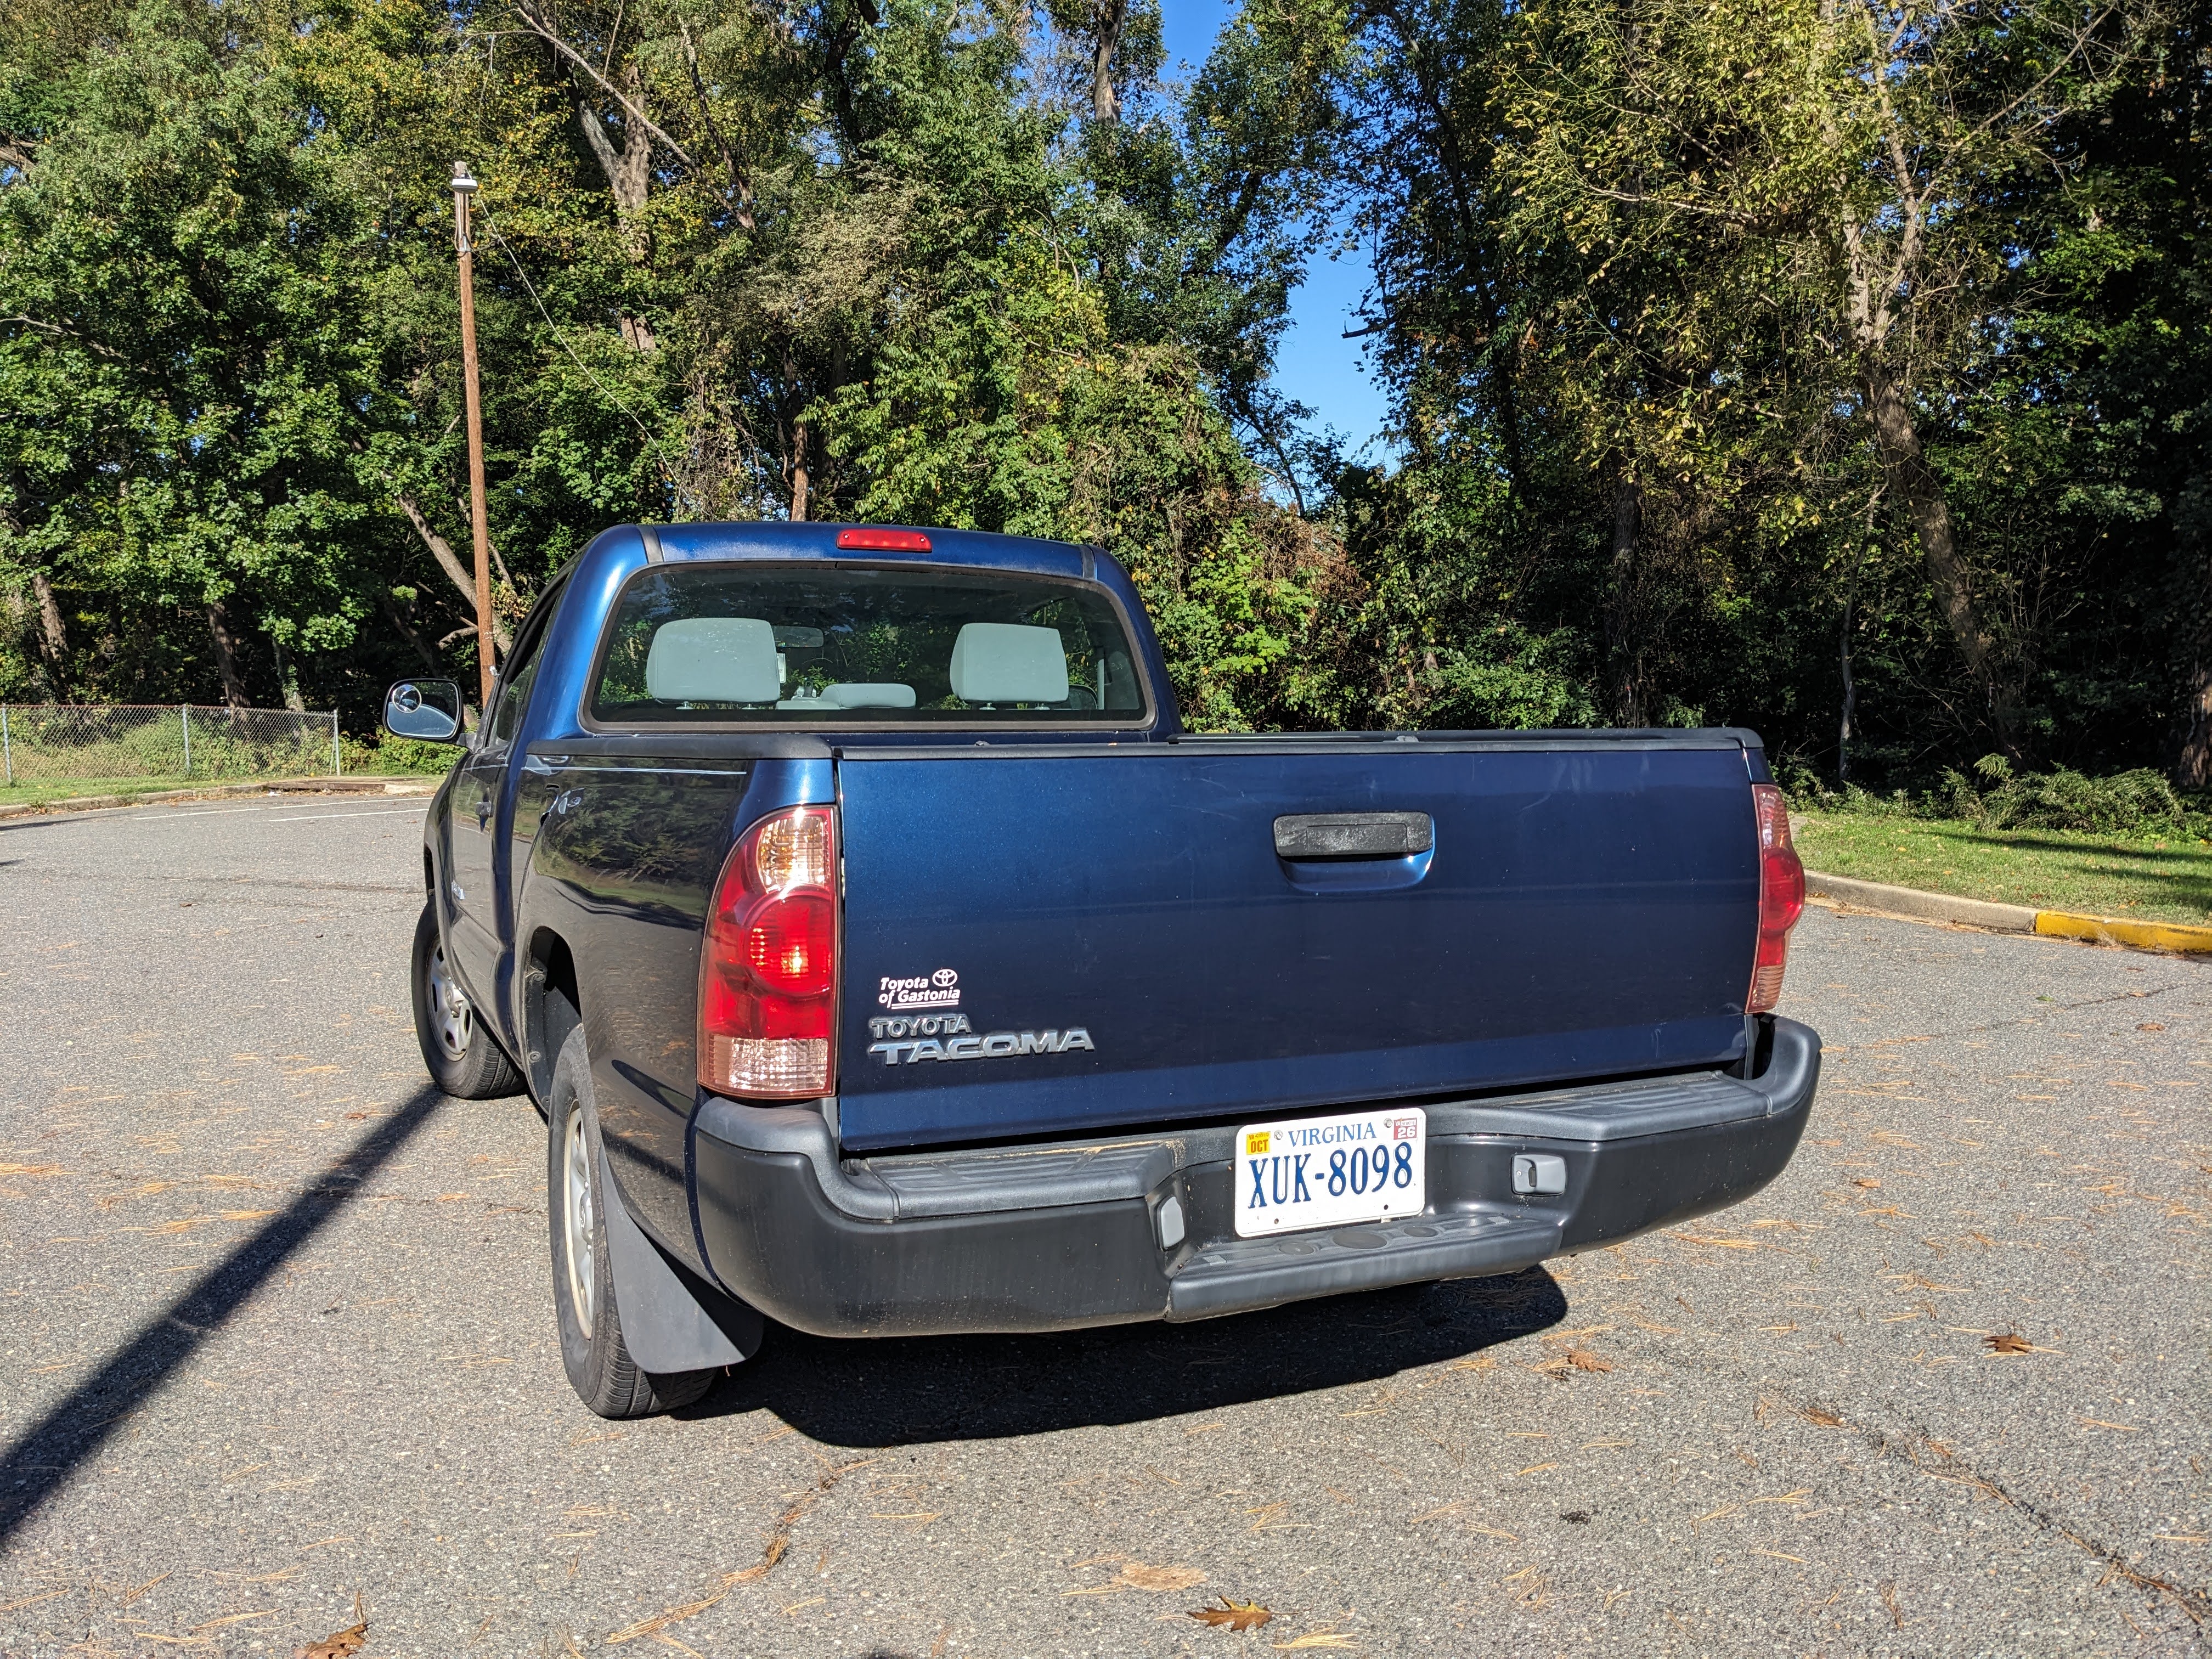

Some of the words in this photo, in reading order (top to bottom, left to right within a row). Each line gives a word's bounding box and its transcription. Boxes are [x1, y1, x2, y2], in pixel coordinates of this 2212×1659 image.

[881, 977, 928, 991] Toyota
[879, 990, 896, 1008] of
[898, 986, 961, 1003] Gastonia
[871, 1014, 972, 1039] TOYOTA
[869, 1028, 1095, 1066] TACOMA
[1288, 1122, 1376, 1147] VIRGINIA
[1397, 1126, 1415, 1138] 26
[1251, 1139, 1268, 1153] OCT
[1248, 1142, 1412, 1209] XUK-8098
